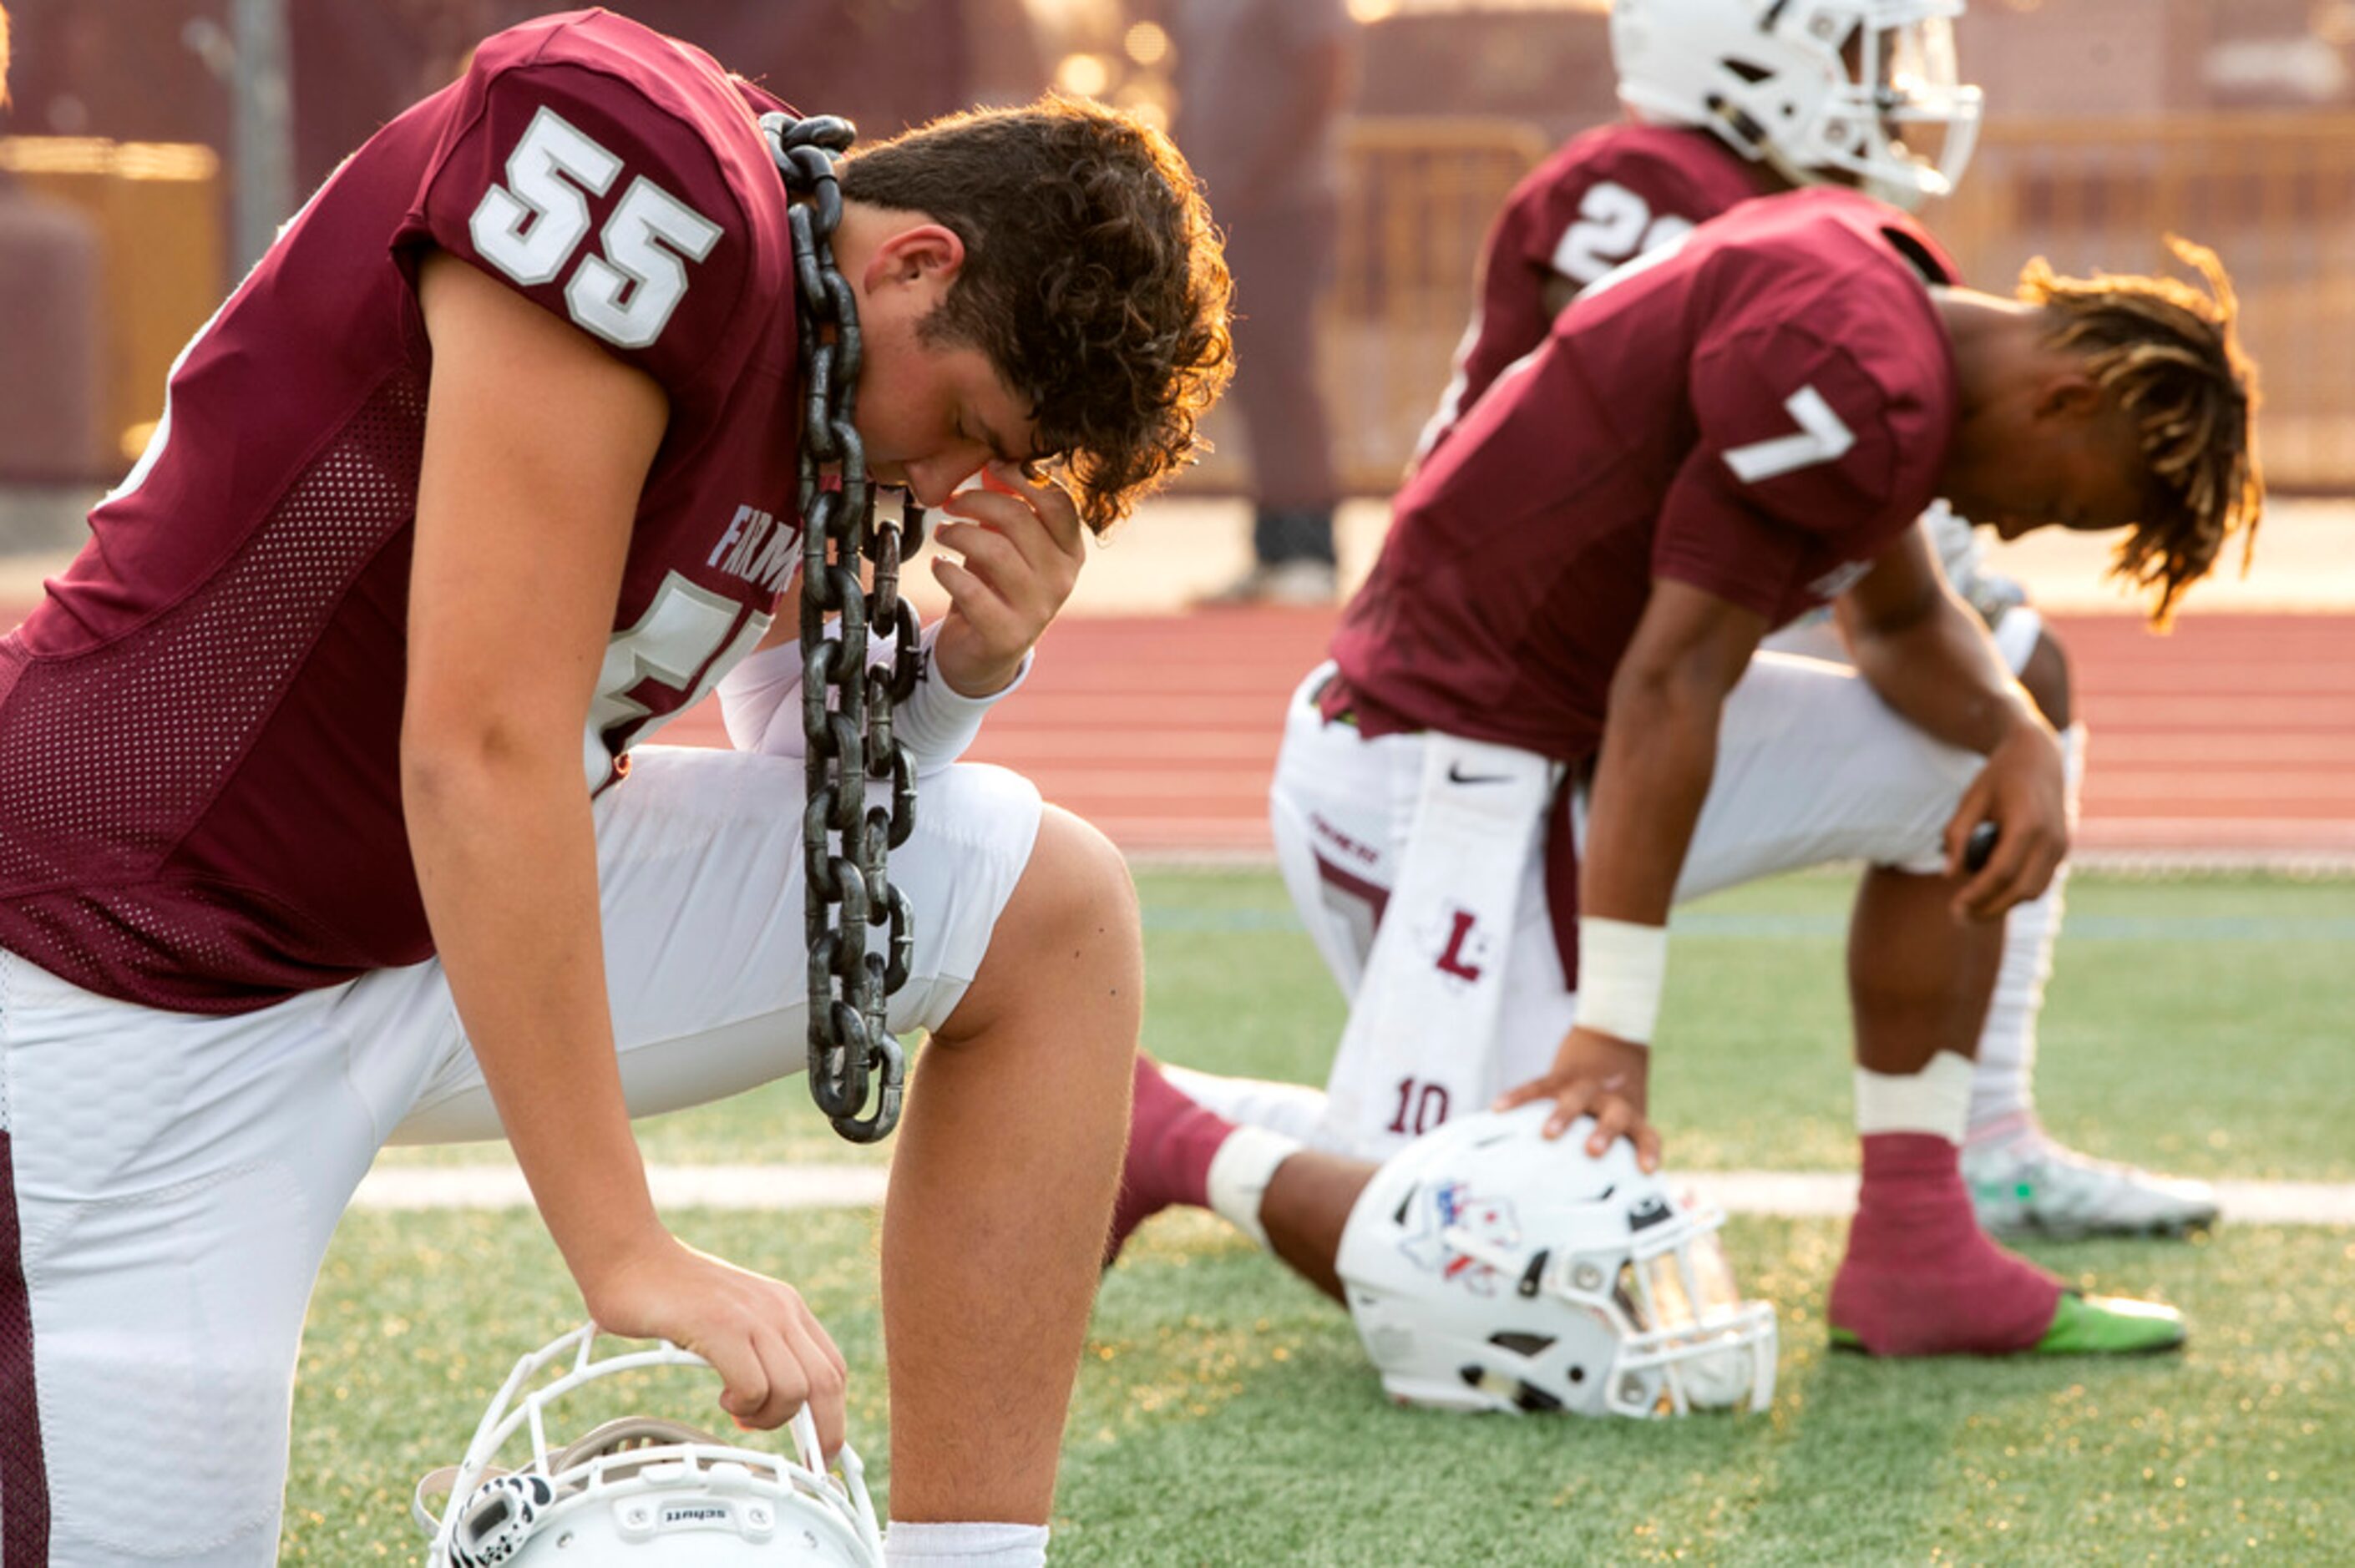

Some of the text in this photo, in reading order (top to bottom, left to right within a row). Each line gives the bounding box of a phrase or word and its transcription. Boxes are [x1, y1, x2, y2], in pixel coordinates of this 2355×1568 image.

[468, 104, 724, 349] 55
[1721, 383, 1857, 483] 7
[1436, 908, 1482, 983] L
[1389, 1076, 1450, 1136] 10
